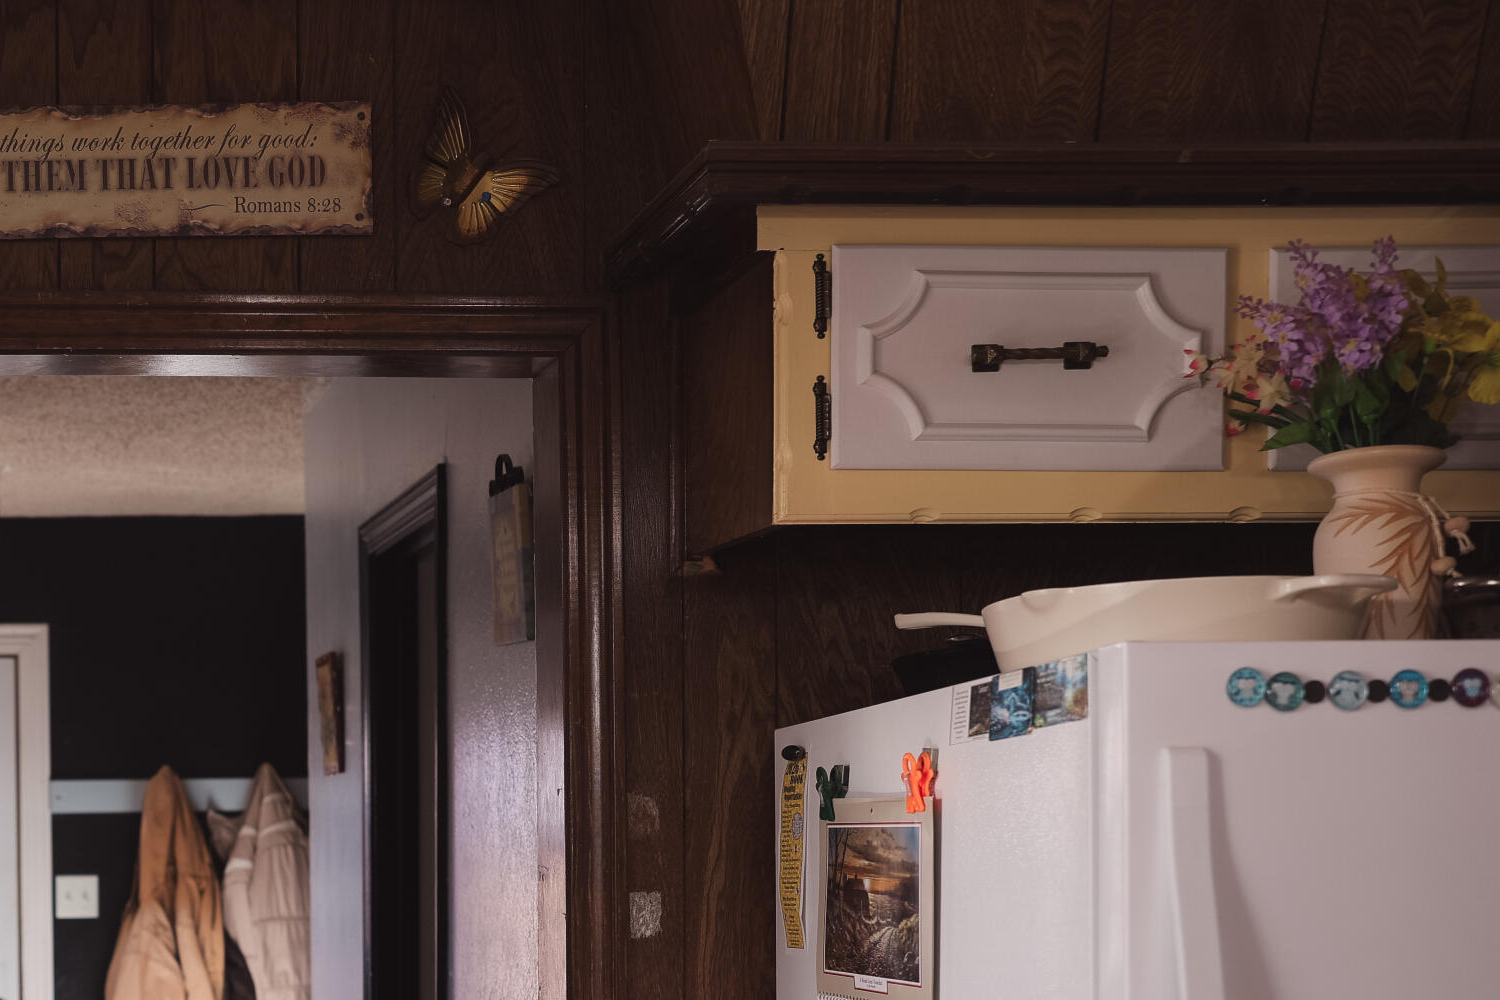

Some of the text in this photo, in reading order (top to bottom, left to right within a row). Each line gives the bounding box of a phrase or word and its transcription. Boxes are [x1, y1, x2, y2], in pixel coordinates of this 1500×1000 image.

[0, 127, 64, 166] things
[72, 127, 125, 152] work
[131, 125, 216, 160] together
[217, 123, 252, 157] for
[257, 123, 318, 161] good:
[2, 158, 87, 194] THEM
[96, 156, 177, 192] THAT
[186, 154, 258, 190] LOVE
[267, 154, 327, 189] GOD
[234, 196, 342, 214] Romans 8:28
